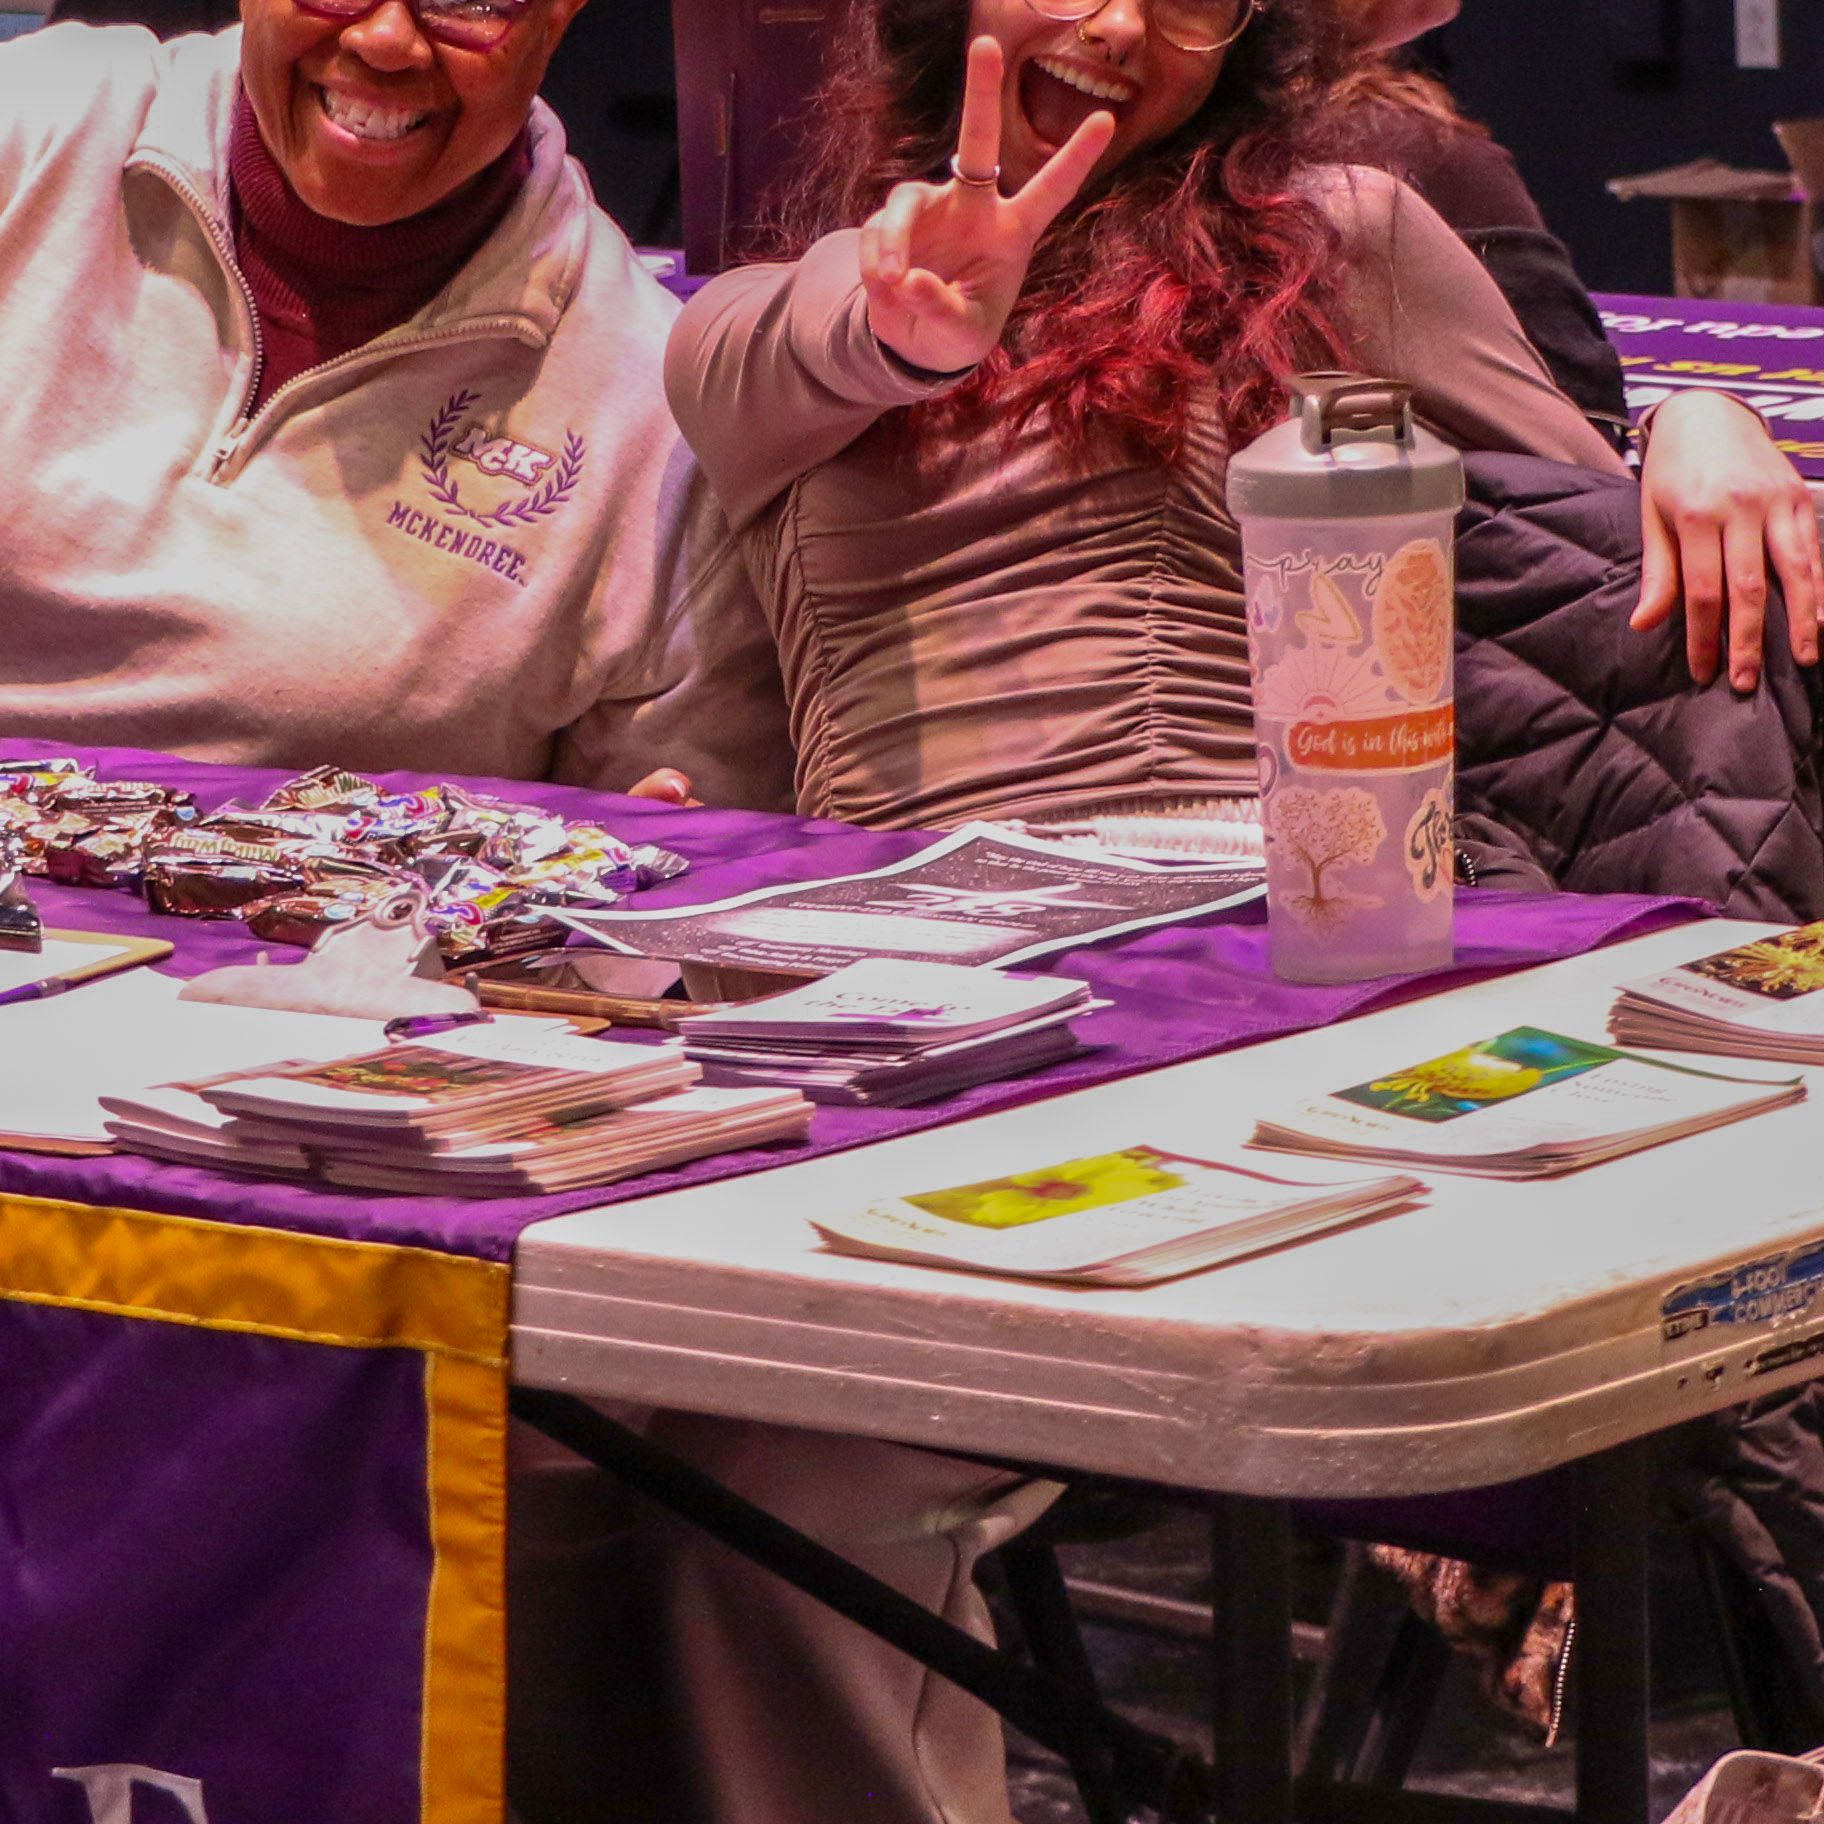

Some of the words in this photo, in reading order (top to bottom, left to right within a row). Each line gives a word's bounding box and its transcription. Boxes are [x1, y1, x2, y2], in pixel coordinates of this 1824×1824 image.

[1296, 727, 1338, 757] God
[1342, 734, 1357, 757] is
[1363, 733, 1382, 753] in
